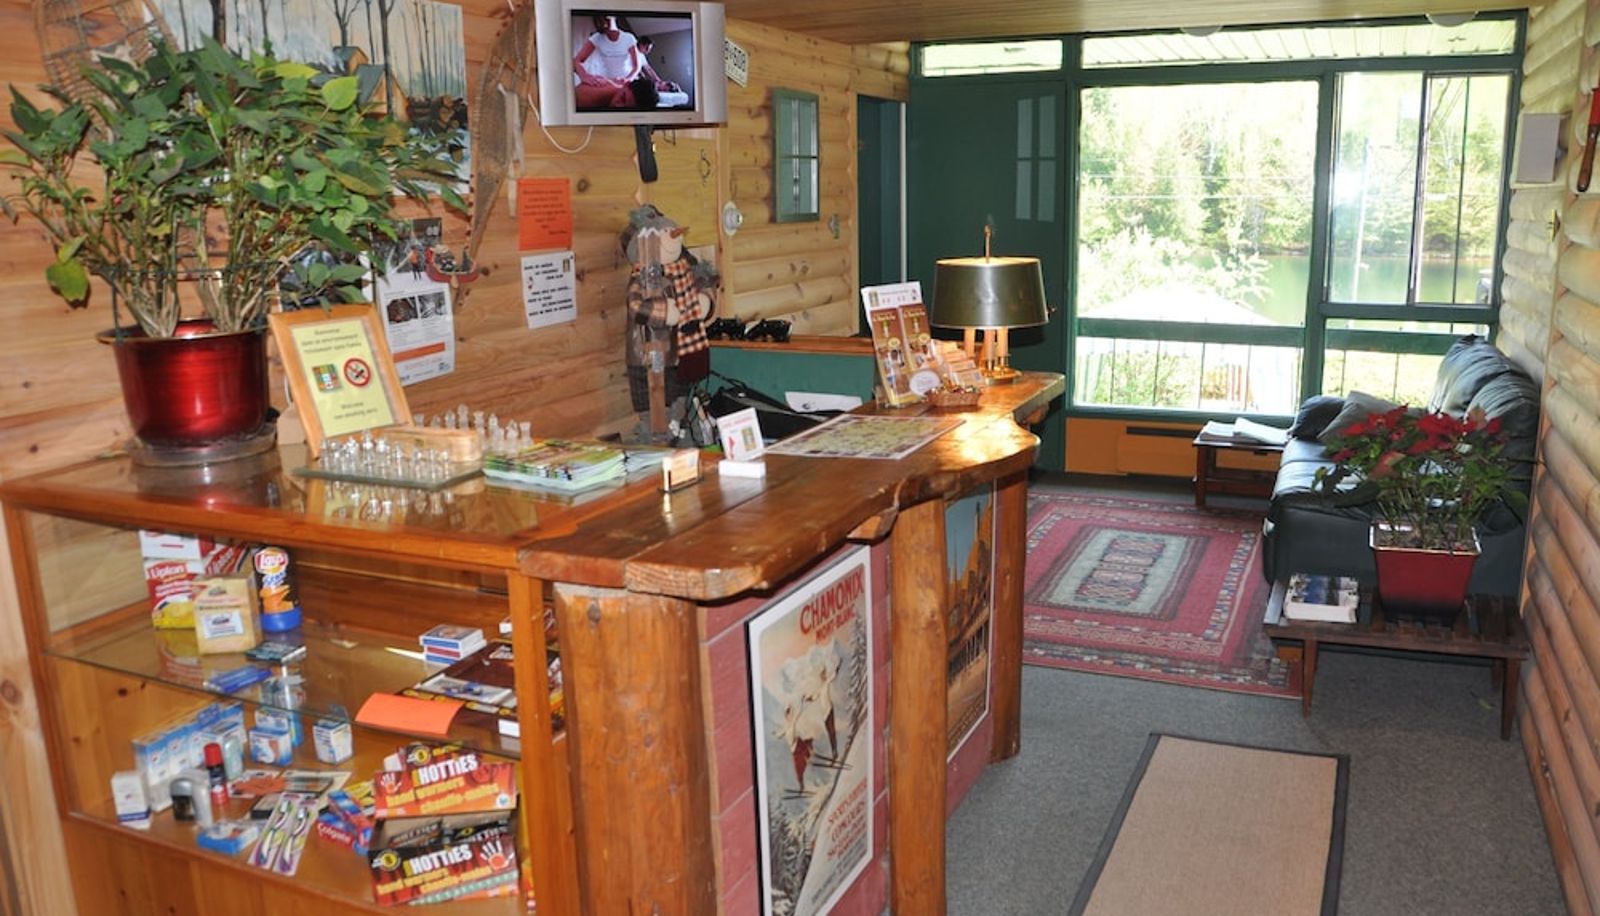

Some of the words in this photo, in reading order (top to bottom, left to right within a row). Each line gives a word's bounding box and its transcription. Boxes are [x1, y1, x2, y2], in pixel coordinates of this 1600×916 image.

[150, 564, 187, 578] Lipton
[800, 570, 865, 636] CHAMONIX
[317, 822, 353, 844] Colgate
